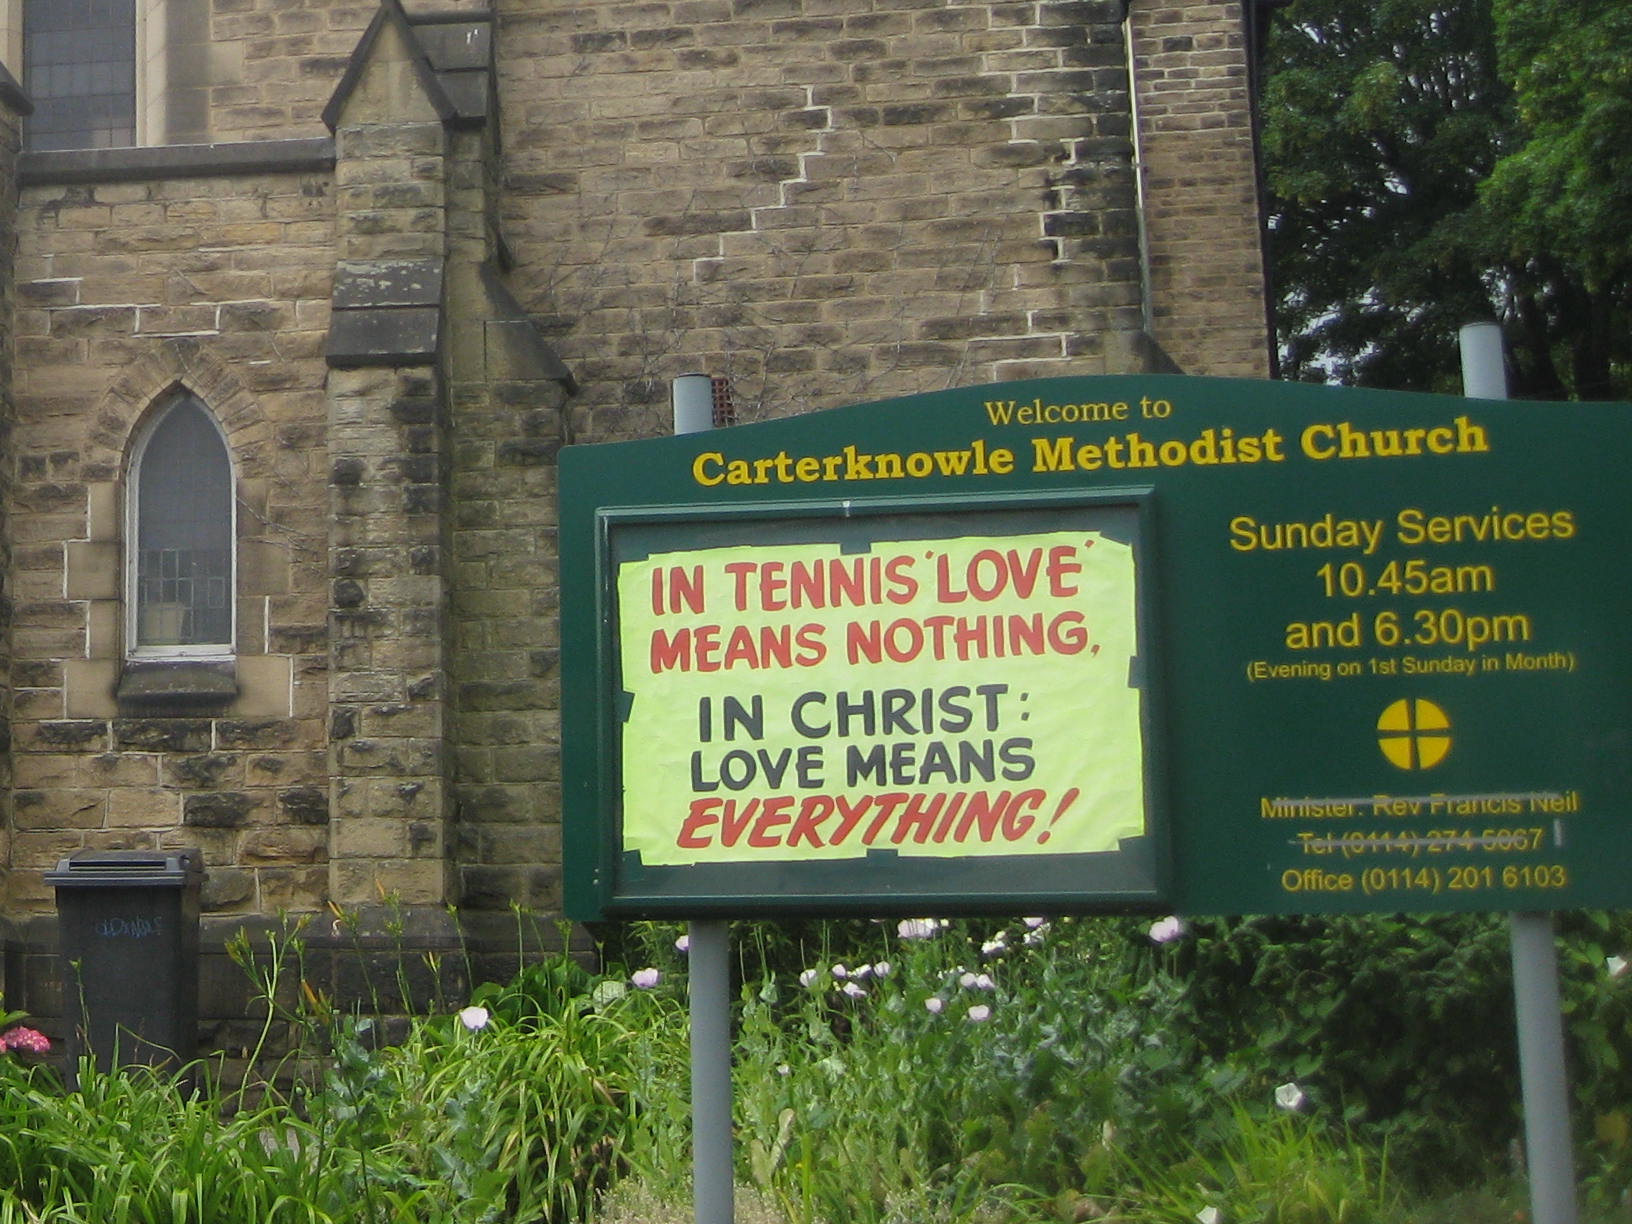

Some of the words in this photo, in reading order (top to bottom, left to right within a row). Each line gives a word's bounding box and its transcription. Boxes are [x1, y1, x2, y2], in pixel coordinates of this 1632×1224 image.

[984, 397, 1129, 426] Welcome
[1140, 395, 1171, 419] to
[692, 440, 1014, 487] Carterknowle
[1031, 425, 1284, 473] Methodist
[1300, 417, 1489, 459] Church
[1229, 513, 1383, 555] Sunday
[1396, 506, 1575, 545] Services
[651, 564, 705, 616] IN
[725, 555, 920, 612] TENNIS
[1317, 559, 1494, 597] 10.45am
[650, 623, 827, 674] MEANS
[846, 610, 1101, 666] NOTHING,
[1285, 612, 1362, 649] and
[1374, 608, 1530, 652] 6.30pm
[1246, 660, 1332, 682] (Evening
[1337, 659, 1361, 676] on
[1370, 658, 1397, 675] 1st
[1402, 655, 1477, 677] Sunday
[1481, 653, 1500, 672] in
[1505, 650, 1575, 673] Month)
[698, 694, 764, 743] IN
[790, 684, 1030, 738] CHRIST:
[690, 745, 825, 792] LOVE
[846, 737, 1035, 787] MEANS
[676, 786, 1081, 850] EVERYTHING!
[1372, 793, 1421, 816] Rev
[1429, 792, 1522, 815] Francis
[1530, 790, 1580, 813] Neil
[1297, 831, 1334, 855] Tel
[1341, 830, 1419, 858] (0114)
[1427, 829, 1475, 853] 274
[1282, 867, 1354, 892] Office
[1361, 865, 1442, 895] (0114)
[1448, 866, 1493, 890] 201
[1502, 864, 1567, 888] 6103
